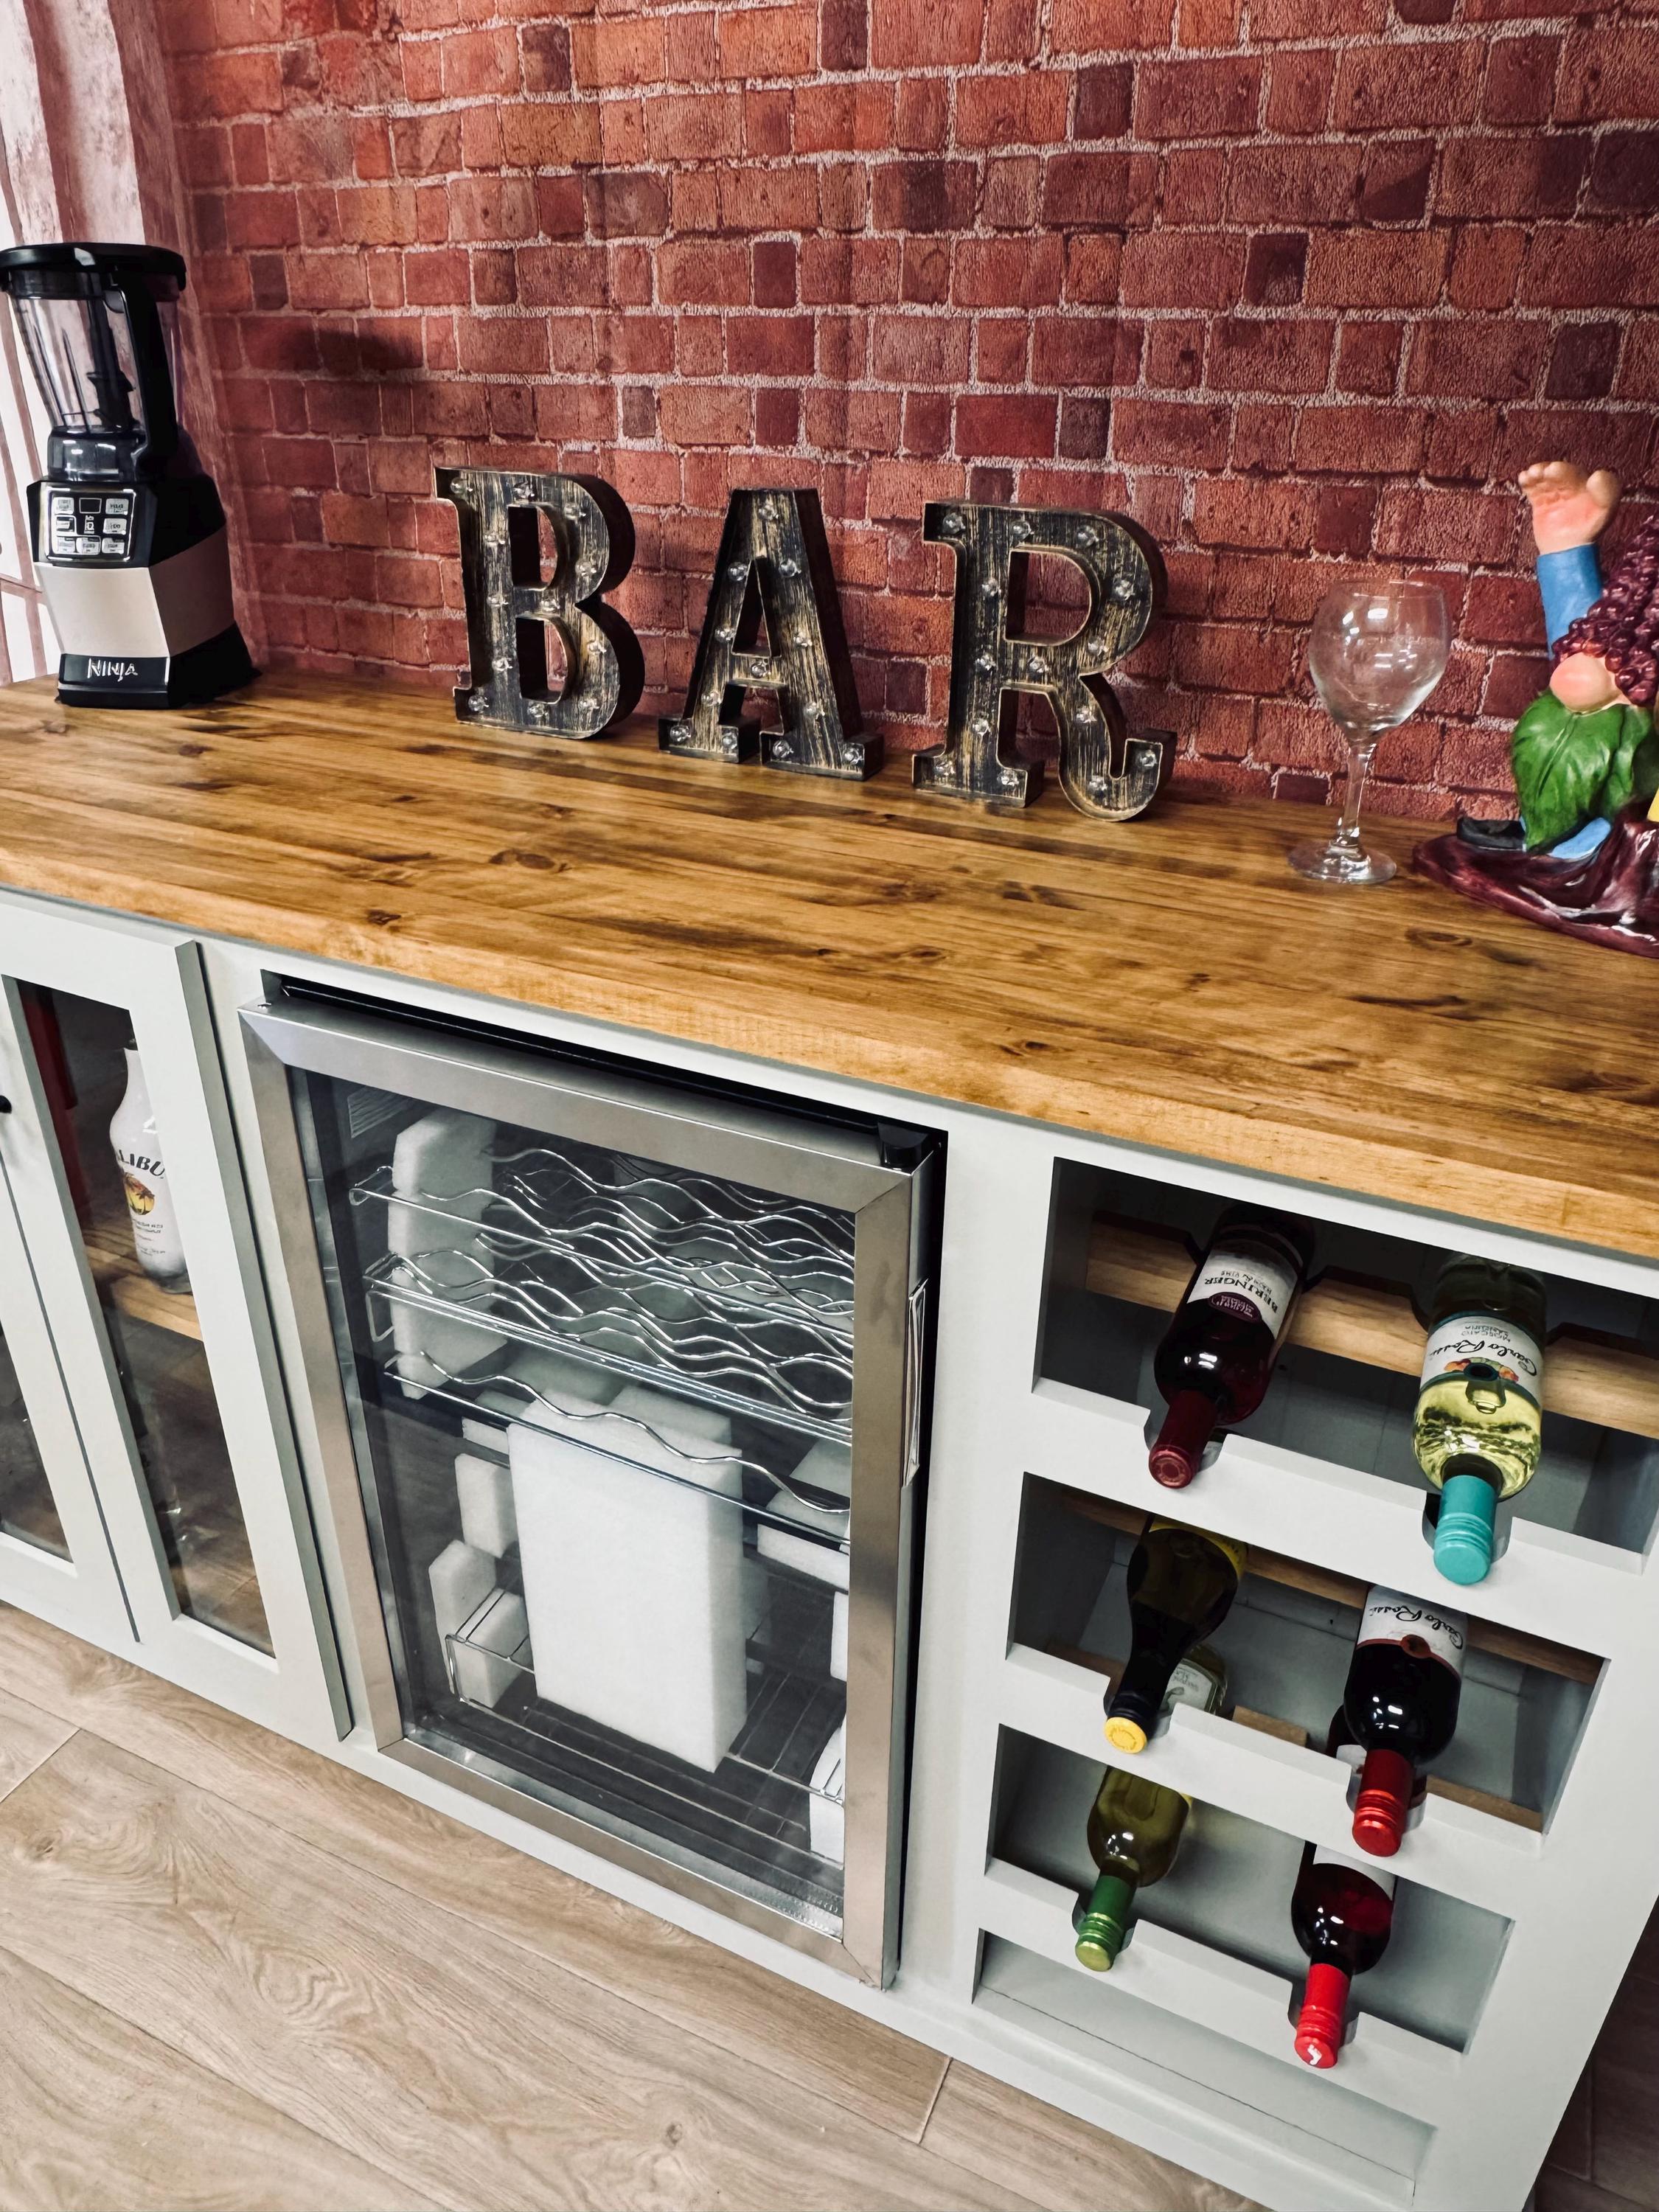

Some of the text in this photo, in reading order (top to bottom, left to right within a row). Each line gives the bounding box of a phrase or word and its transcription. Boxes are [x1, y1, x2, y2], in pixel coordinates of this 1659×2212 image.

[436, 466, 1177, 823] BAR
[1204, 1277, 1278, 1313] BERINGER
[1429, 1340, 1537, 1377] Carlo Rossi
[1425, 1615, 1464, 1649] Carlo
